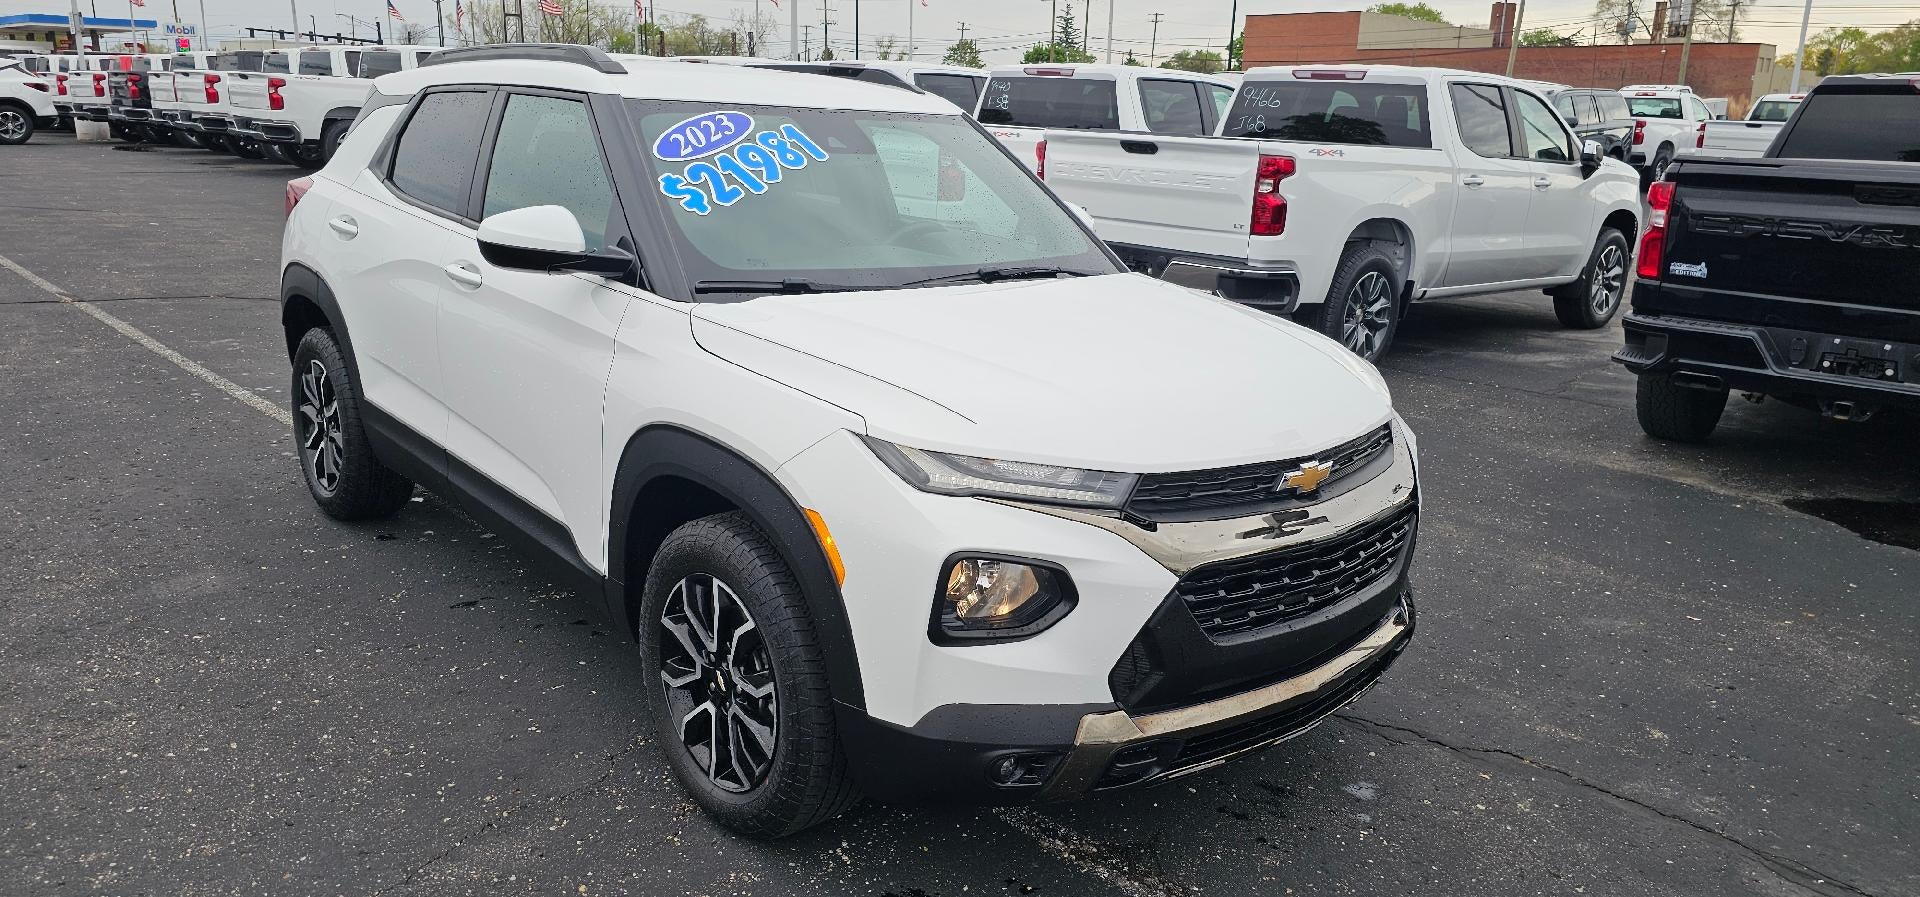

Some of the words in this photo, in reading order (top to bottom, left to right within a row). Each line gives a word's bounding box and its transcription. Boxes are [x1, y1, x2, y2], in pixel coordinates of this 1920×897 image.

[166, 25, 195, 35] Mobil
[1243, 86, 1281, 108] 9466
[670, 114, 736, 157] 2023
[658, 124, 829, 216] $21981
[1054, 161, 1238, 192] CHEVROLET
[1233, 222, 1245, 230] LT
[1695, 214, 1920, 250] CHEVR
